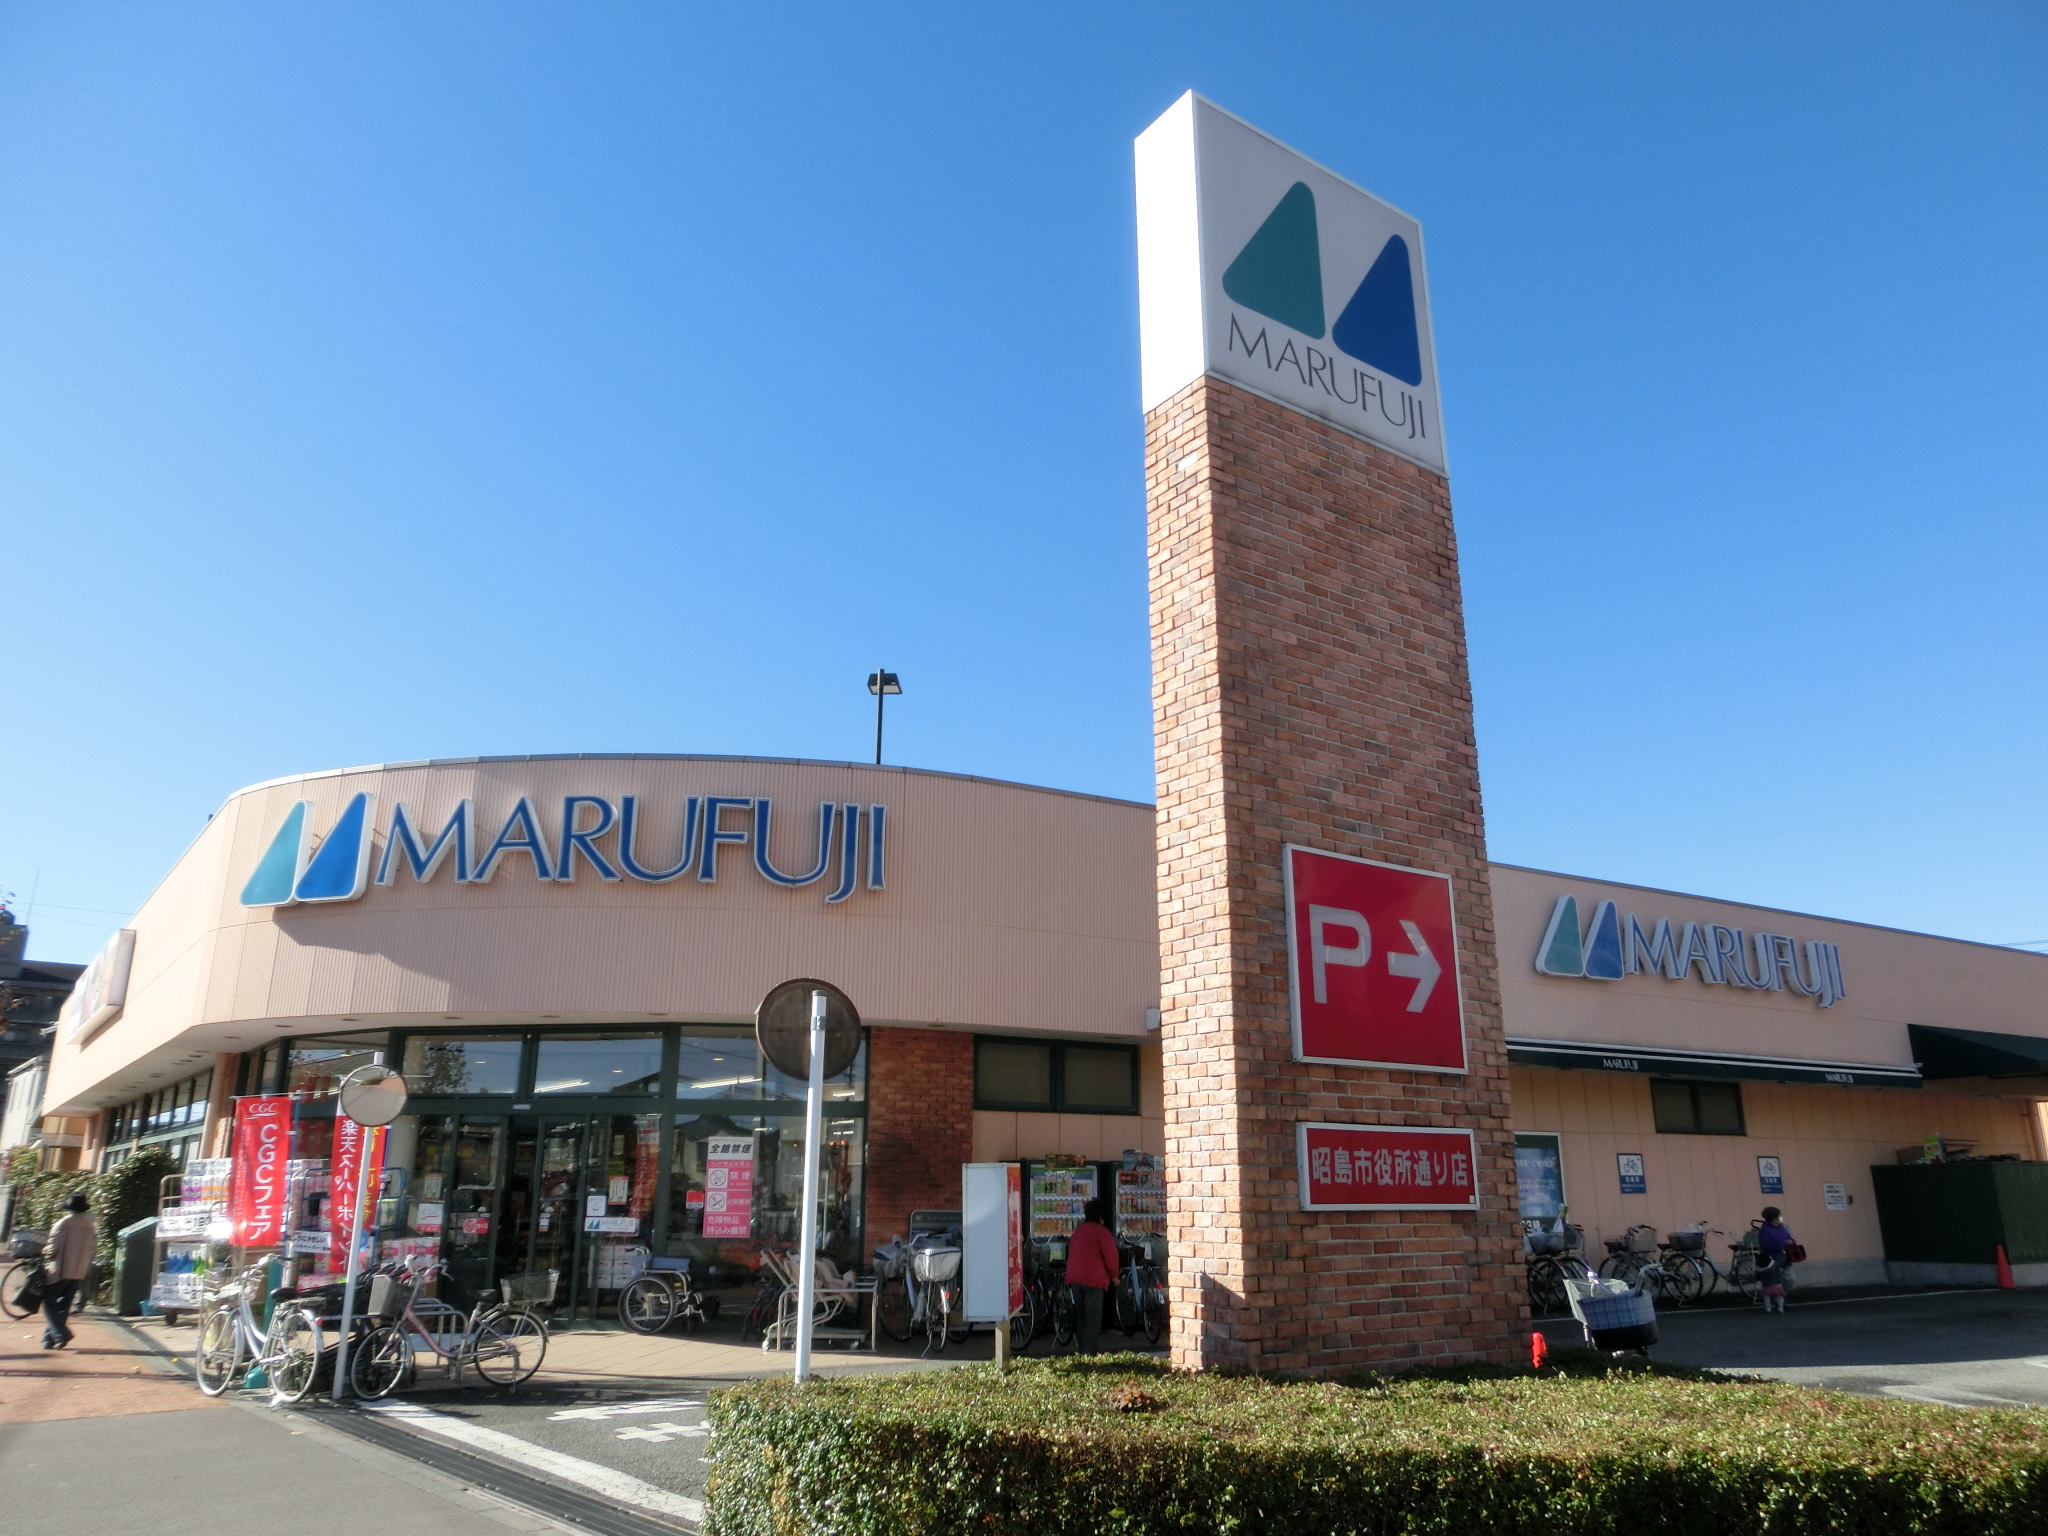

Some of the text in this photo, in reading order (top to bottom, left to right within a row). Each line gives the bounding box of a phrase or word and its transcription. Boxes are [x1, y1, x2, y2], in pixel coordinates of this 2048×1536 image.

[1229, 312, 1426, 439] MARUFUJI
[375, 793, 888, 903] MARUFUJI
[1309, 903, 1372, 1004] P
[1624, 912, 1846, 1008] MARUFUJI
[1603, 1058, 1638, 1070] MARUFUJI
[249, 1103, 278, 1113] CGC
[709, 1143, 752, 1154] 全館禁煙
[1311, 1146, 1468, 1187] 昭島市役所通り店
[250, 1123, 278, 1241] CGCフェア
[706, 1226, 747, 1235] 持込み厳禁
[708, 1215, 740, 1224] 危険物品
